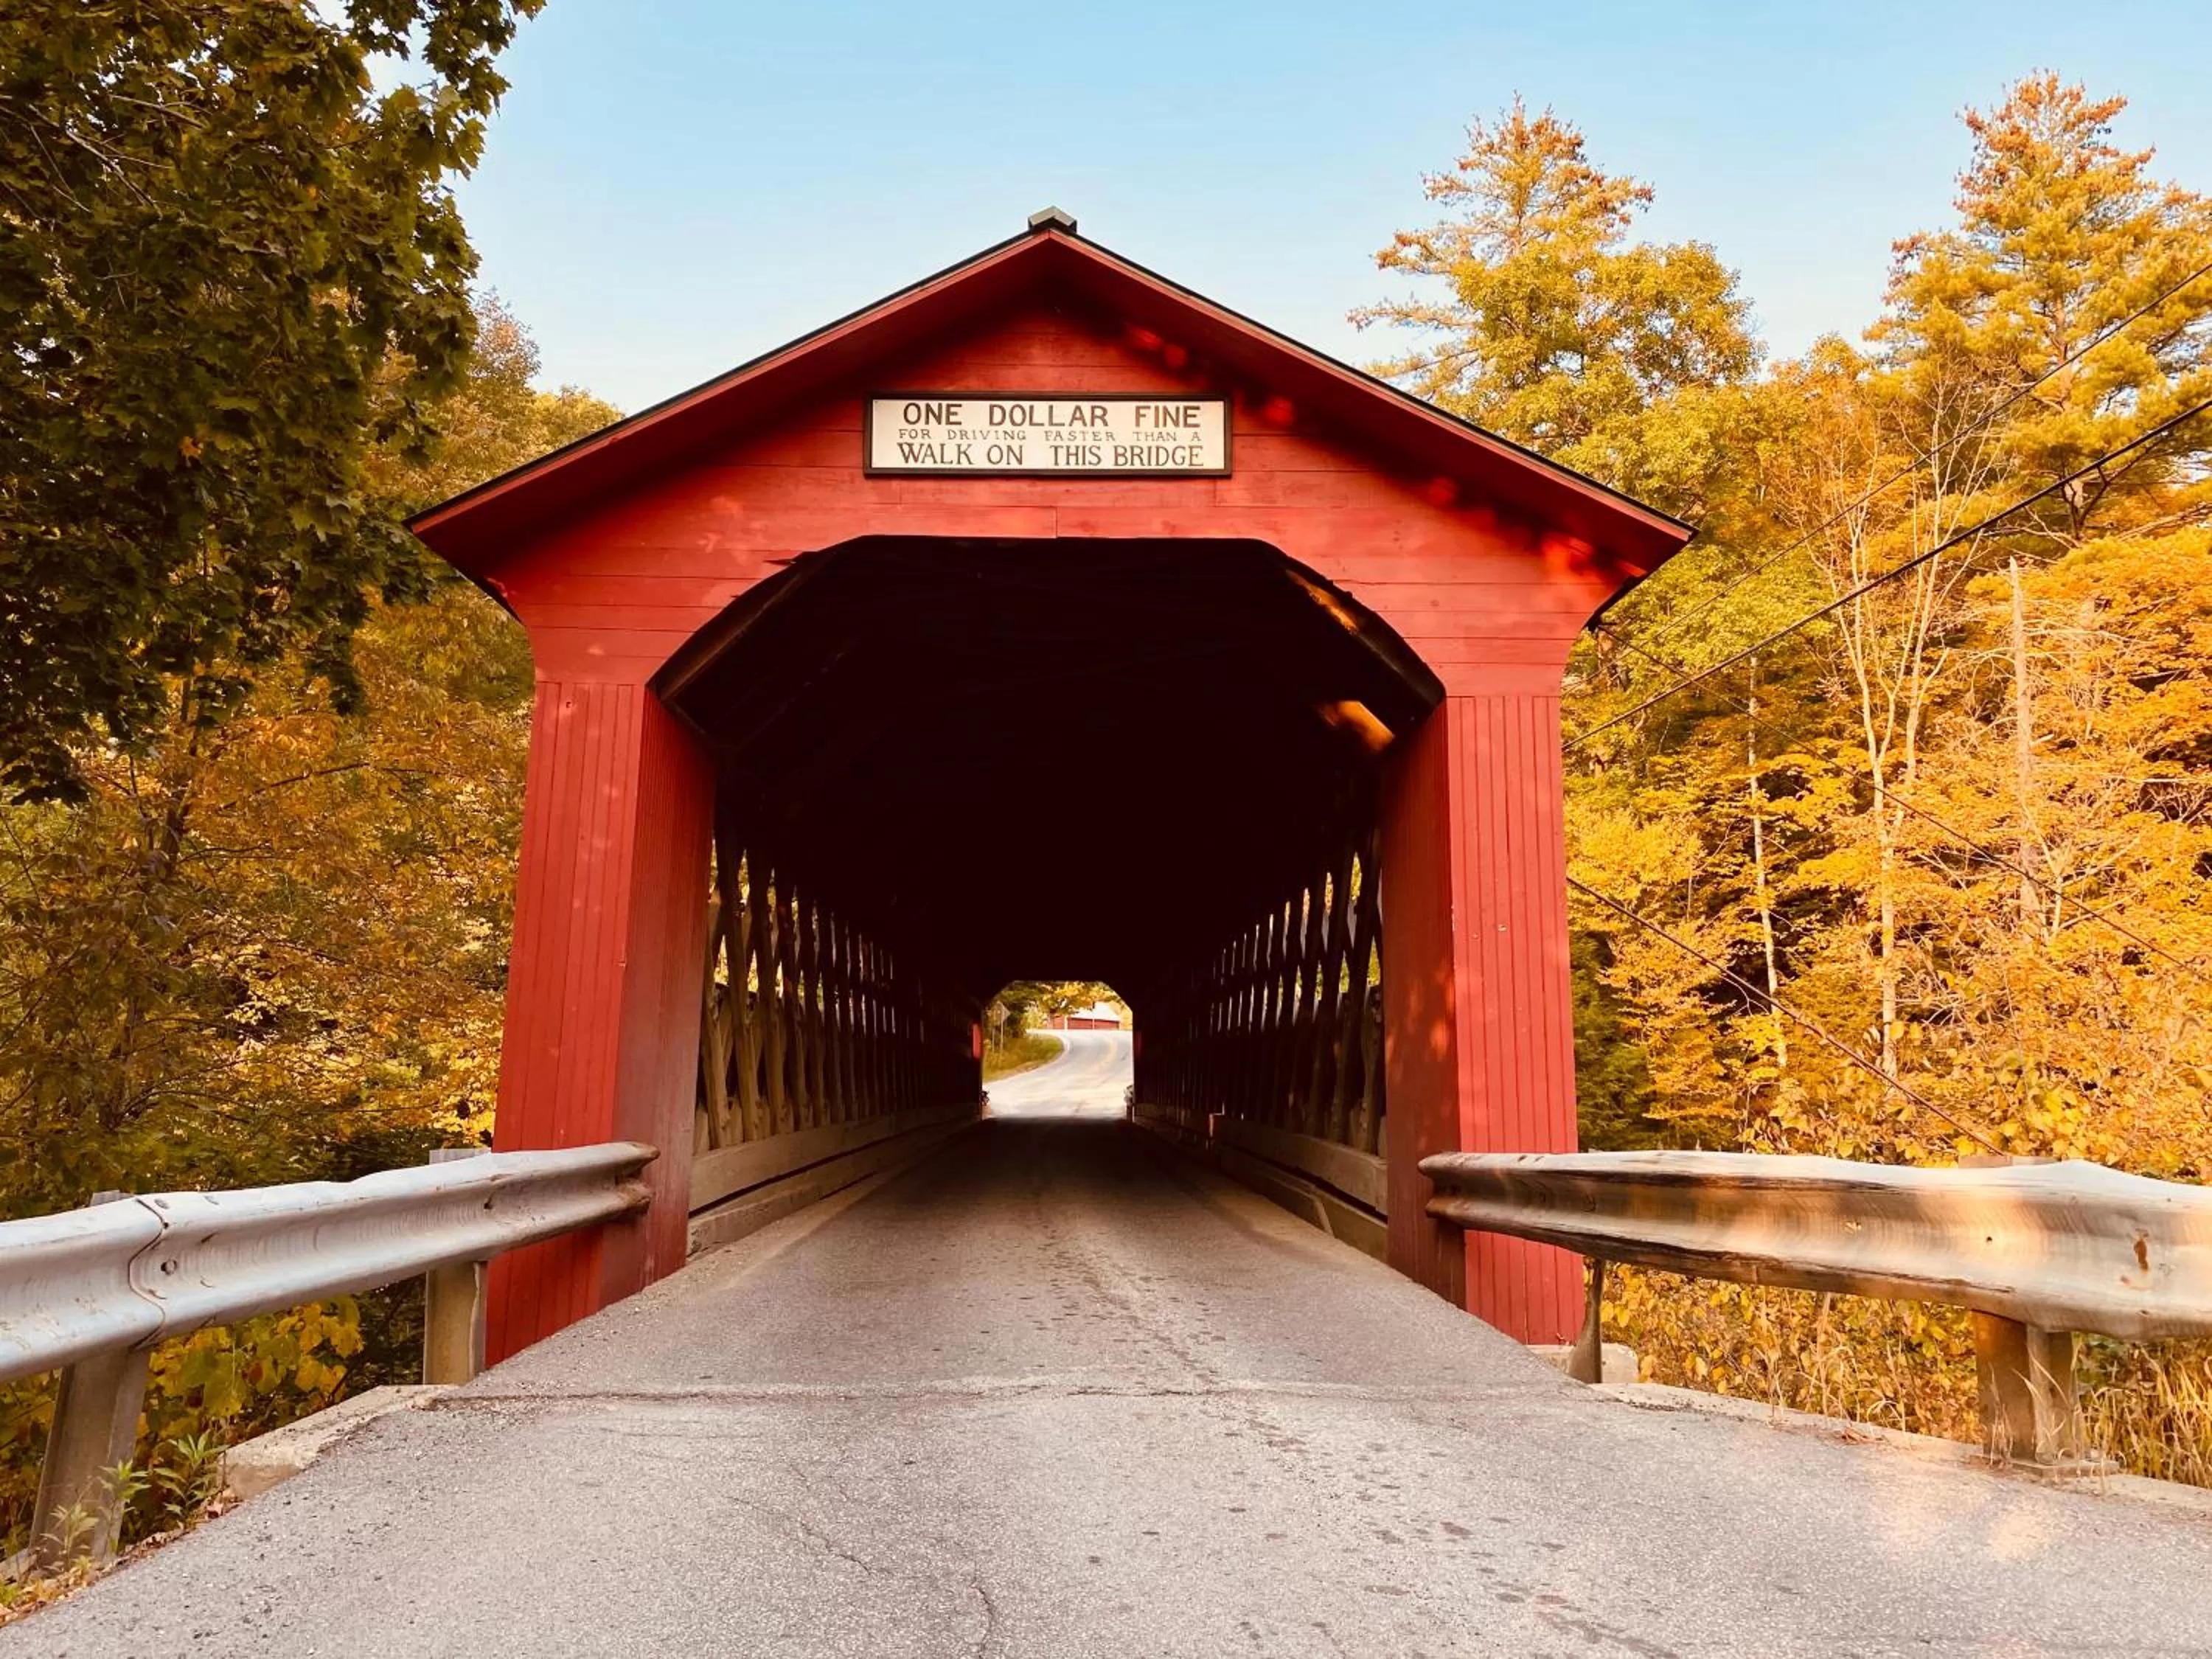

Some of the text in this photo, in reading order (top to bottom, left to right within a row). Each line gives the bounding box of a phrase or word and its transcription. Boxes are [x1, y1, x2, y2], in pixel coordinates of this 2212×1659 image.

[903, 403, 1201, 428] ONE DOLLAR FINE
[898, 428, 1201, 442] FOR DRIVING FASTER THAN A
[897, 442, 1204, 467] WALK ON THIS BRIDGE
